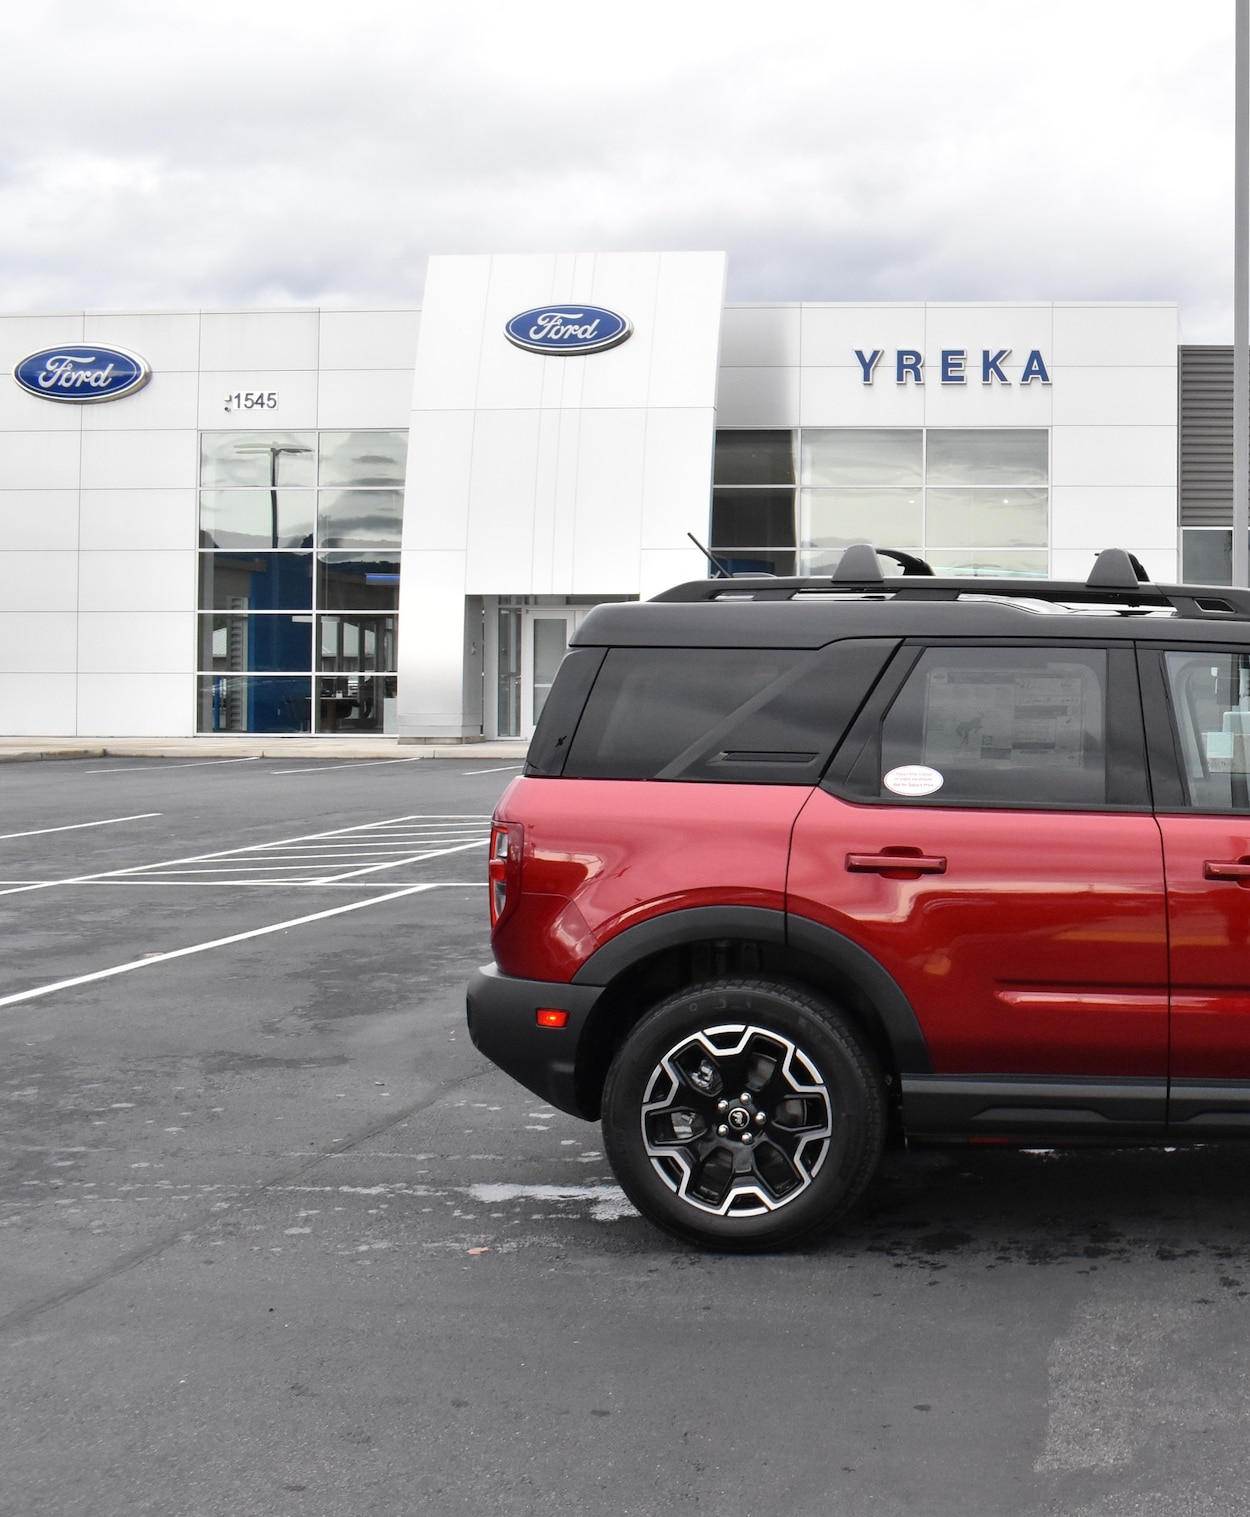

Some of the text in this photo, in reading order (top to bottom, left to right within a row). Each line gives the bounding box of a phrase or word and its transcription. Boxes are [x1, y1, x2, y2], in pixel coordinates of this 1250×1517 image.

[529, 312, 601, 340] Ford
[38, 355, 114, 388] Ford
[853, 348, 1053, 385] YREKA
[233, 392, 278, 409] 1545
